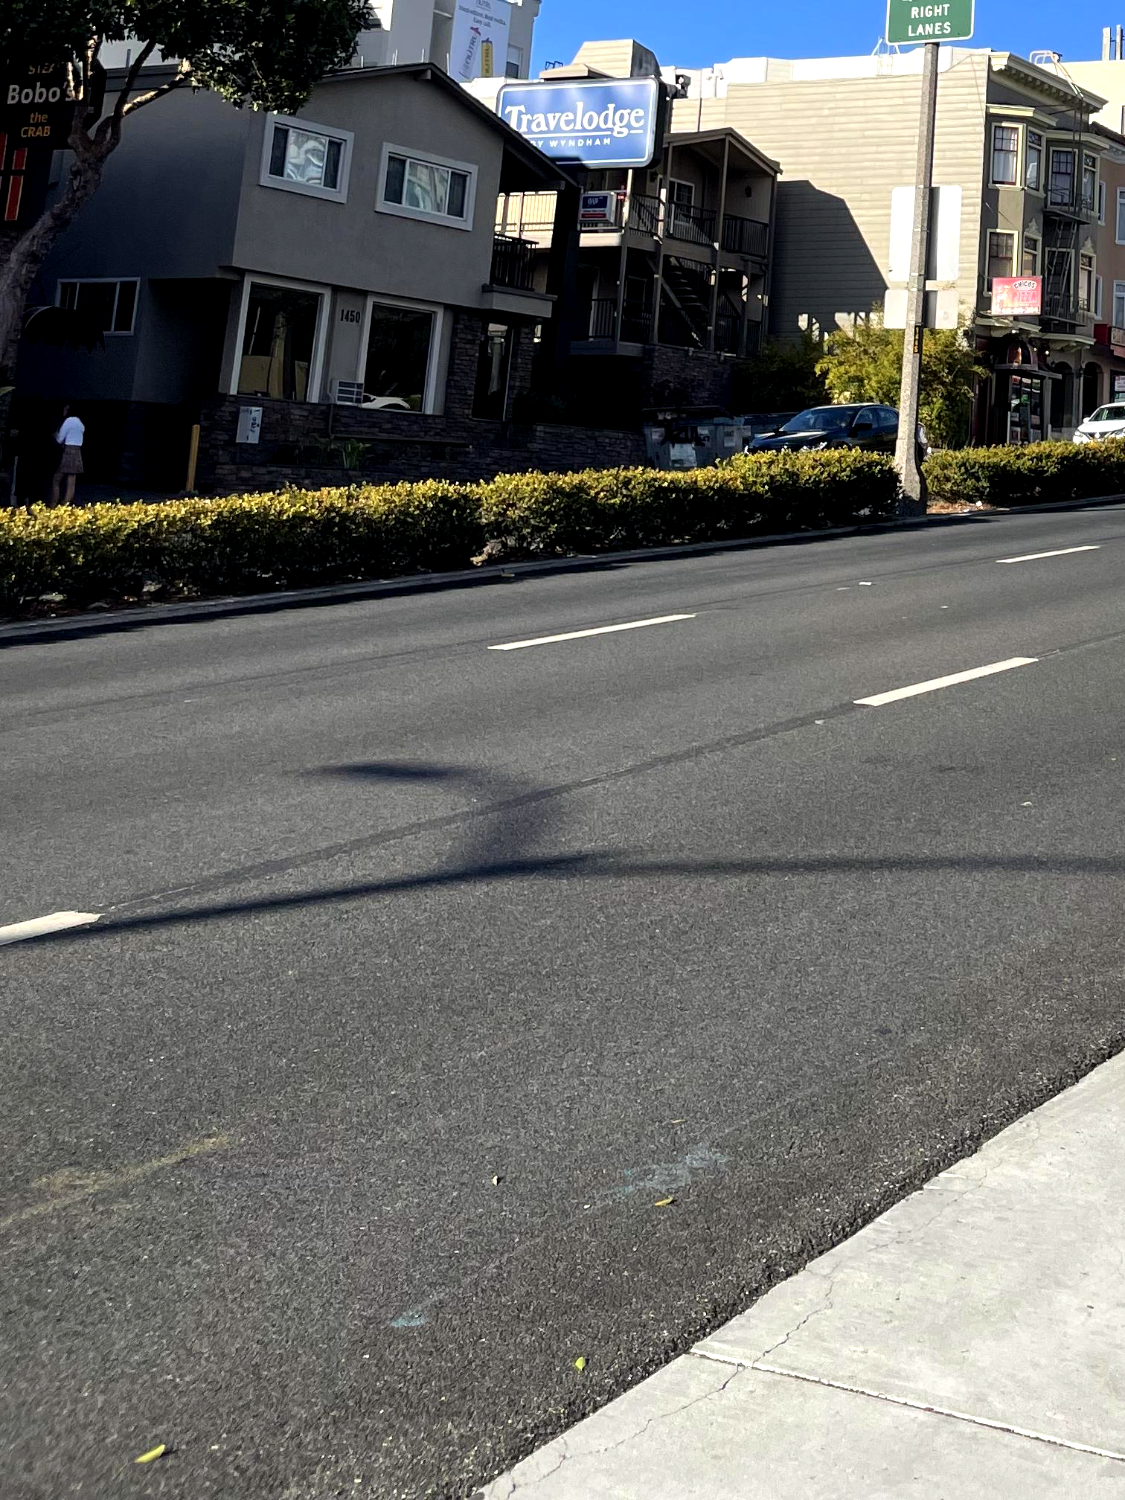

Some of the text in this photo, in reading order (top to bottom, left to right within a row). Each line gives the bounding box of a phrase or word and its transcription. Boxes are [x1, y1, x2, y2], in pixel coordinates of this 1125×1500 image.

[911, 4, 950, 19] RIGHT
[908, 22, 951, 37] LANES
[30, 112, 49, 124] the
[504, 101, 645, 138] Travelodge
[20, 125, 51, 138] CRAB
[549, 138, 611, 148] WYNDHAM
[340, 309, 360, 323] 1450
